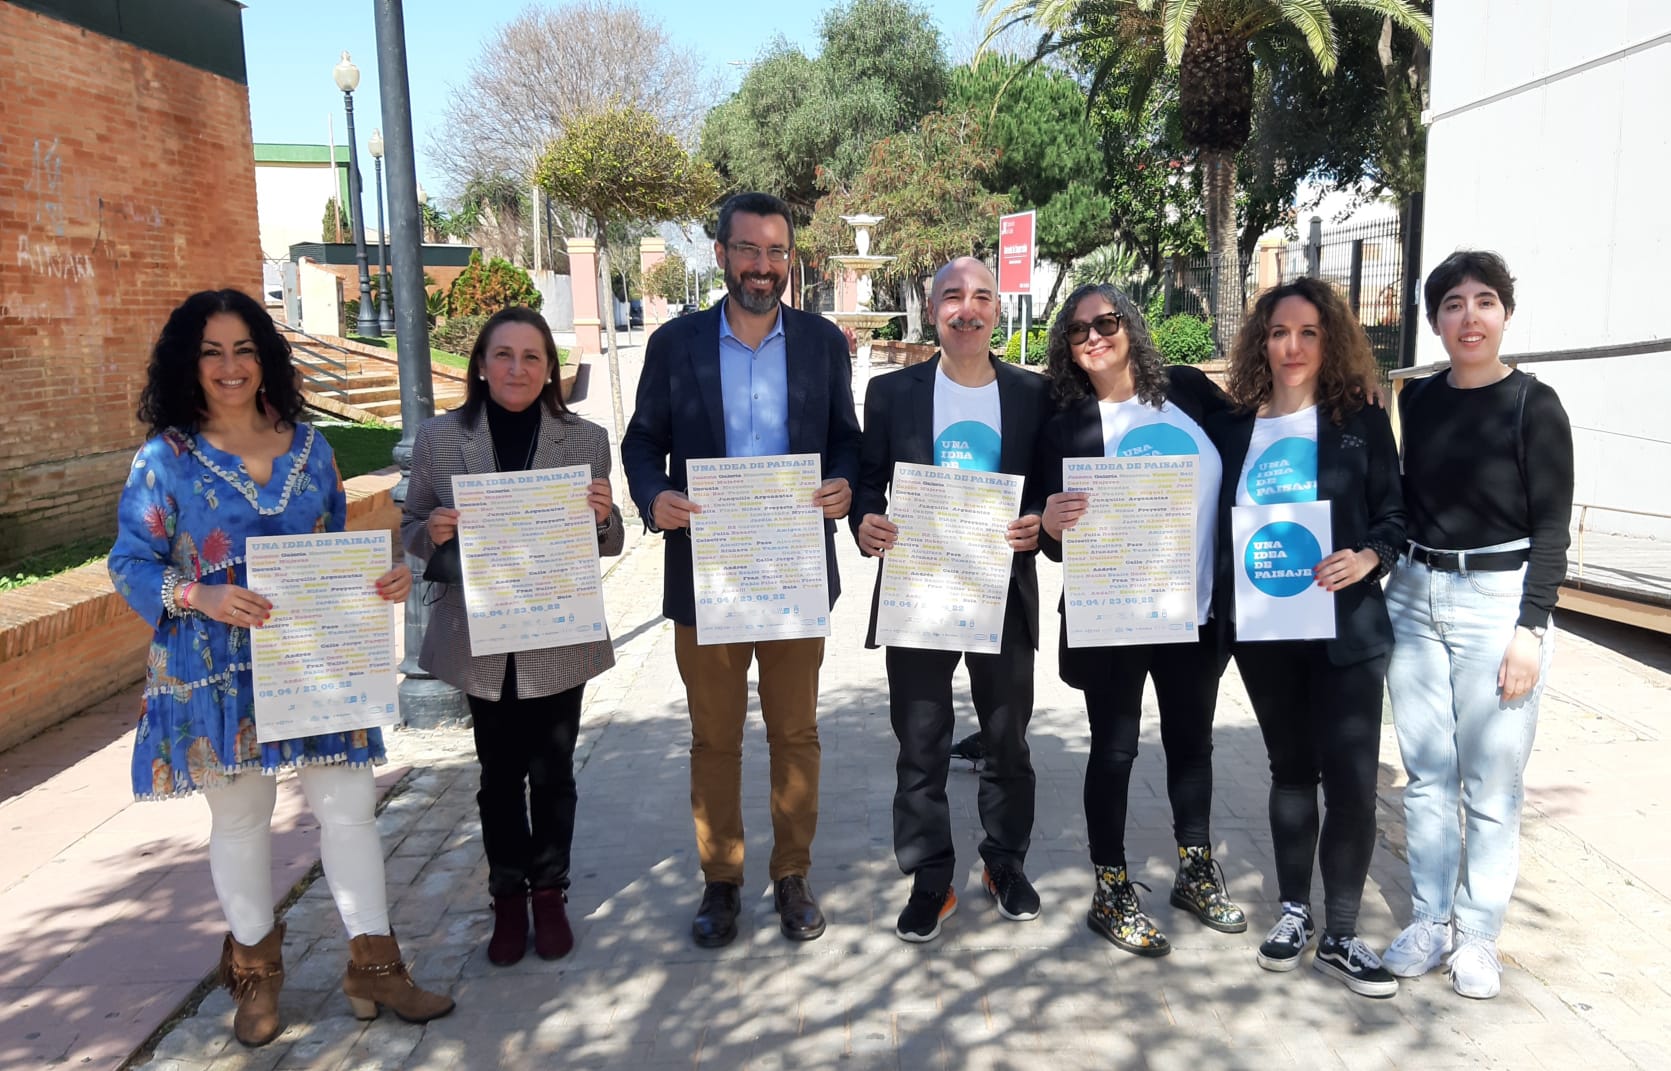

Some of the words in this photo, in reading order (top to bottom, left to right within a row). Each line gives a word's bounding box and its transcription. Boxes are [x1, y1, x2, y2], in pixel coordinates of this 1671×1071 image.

[941, 440, 969, 449] UNA
[941, 450, 974, 460] IDEA
[719, 463, 746, 471] IDEA
[767, 459, 815, 468] PAISAJE
[1069, 464, 1093, 472] UNA
[1096, 463, 1123, 471] IDEA
[1144, 461, 1192, 469] PAISAJE
[1259, 459, 1290, 470] UNA
[899, 468, 923, 477] UNA
[925, 471, 951, 480] IDEA
[954, 474, 969, 482] DE
[971, 476, 1017, 487] PAISAJE
[1256, 467, 1294, 478] IDEA
[458, 480, 484, 489] UNA
[486, 477, 515, 486] IDEA
[536, 471, 586, 482] PAISAJE
[1256, 478, 1277, 487] DE
[252, 542, 279, 551] UNA
[282, 540, 313, 549] IDEA
[316, 539, 332, 547] DE
[335, 536, 386, 546] PAISAJE
[1253, 541, 1282, 550] UNA
[1253, 551, 1287, 560] IDEA
[1254, 561, 1272, 569] DE
[1255, 568, 1312, 579] PAISAJE
